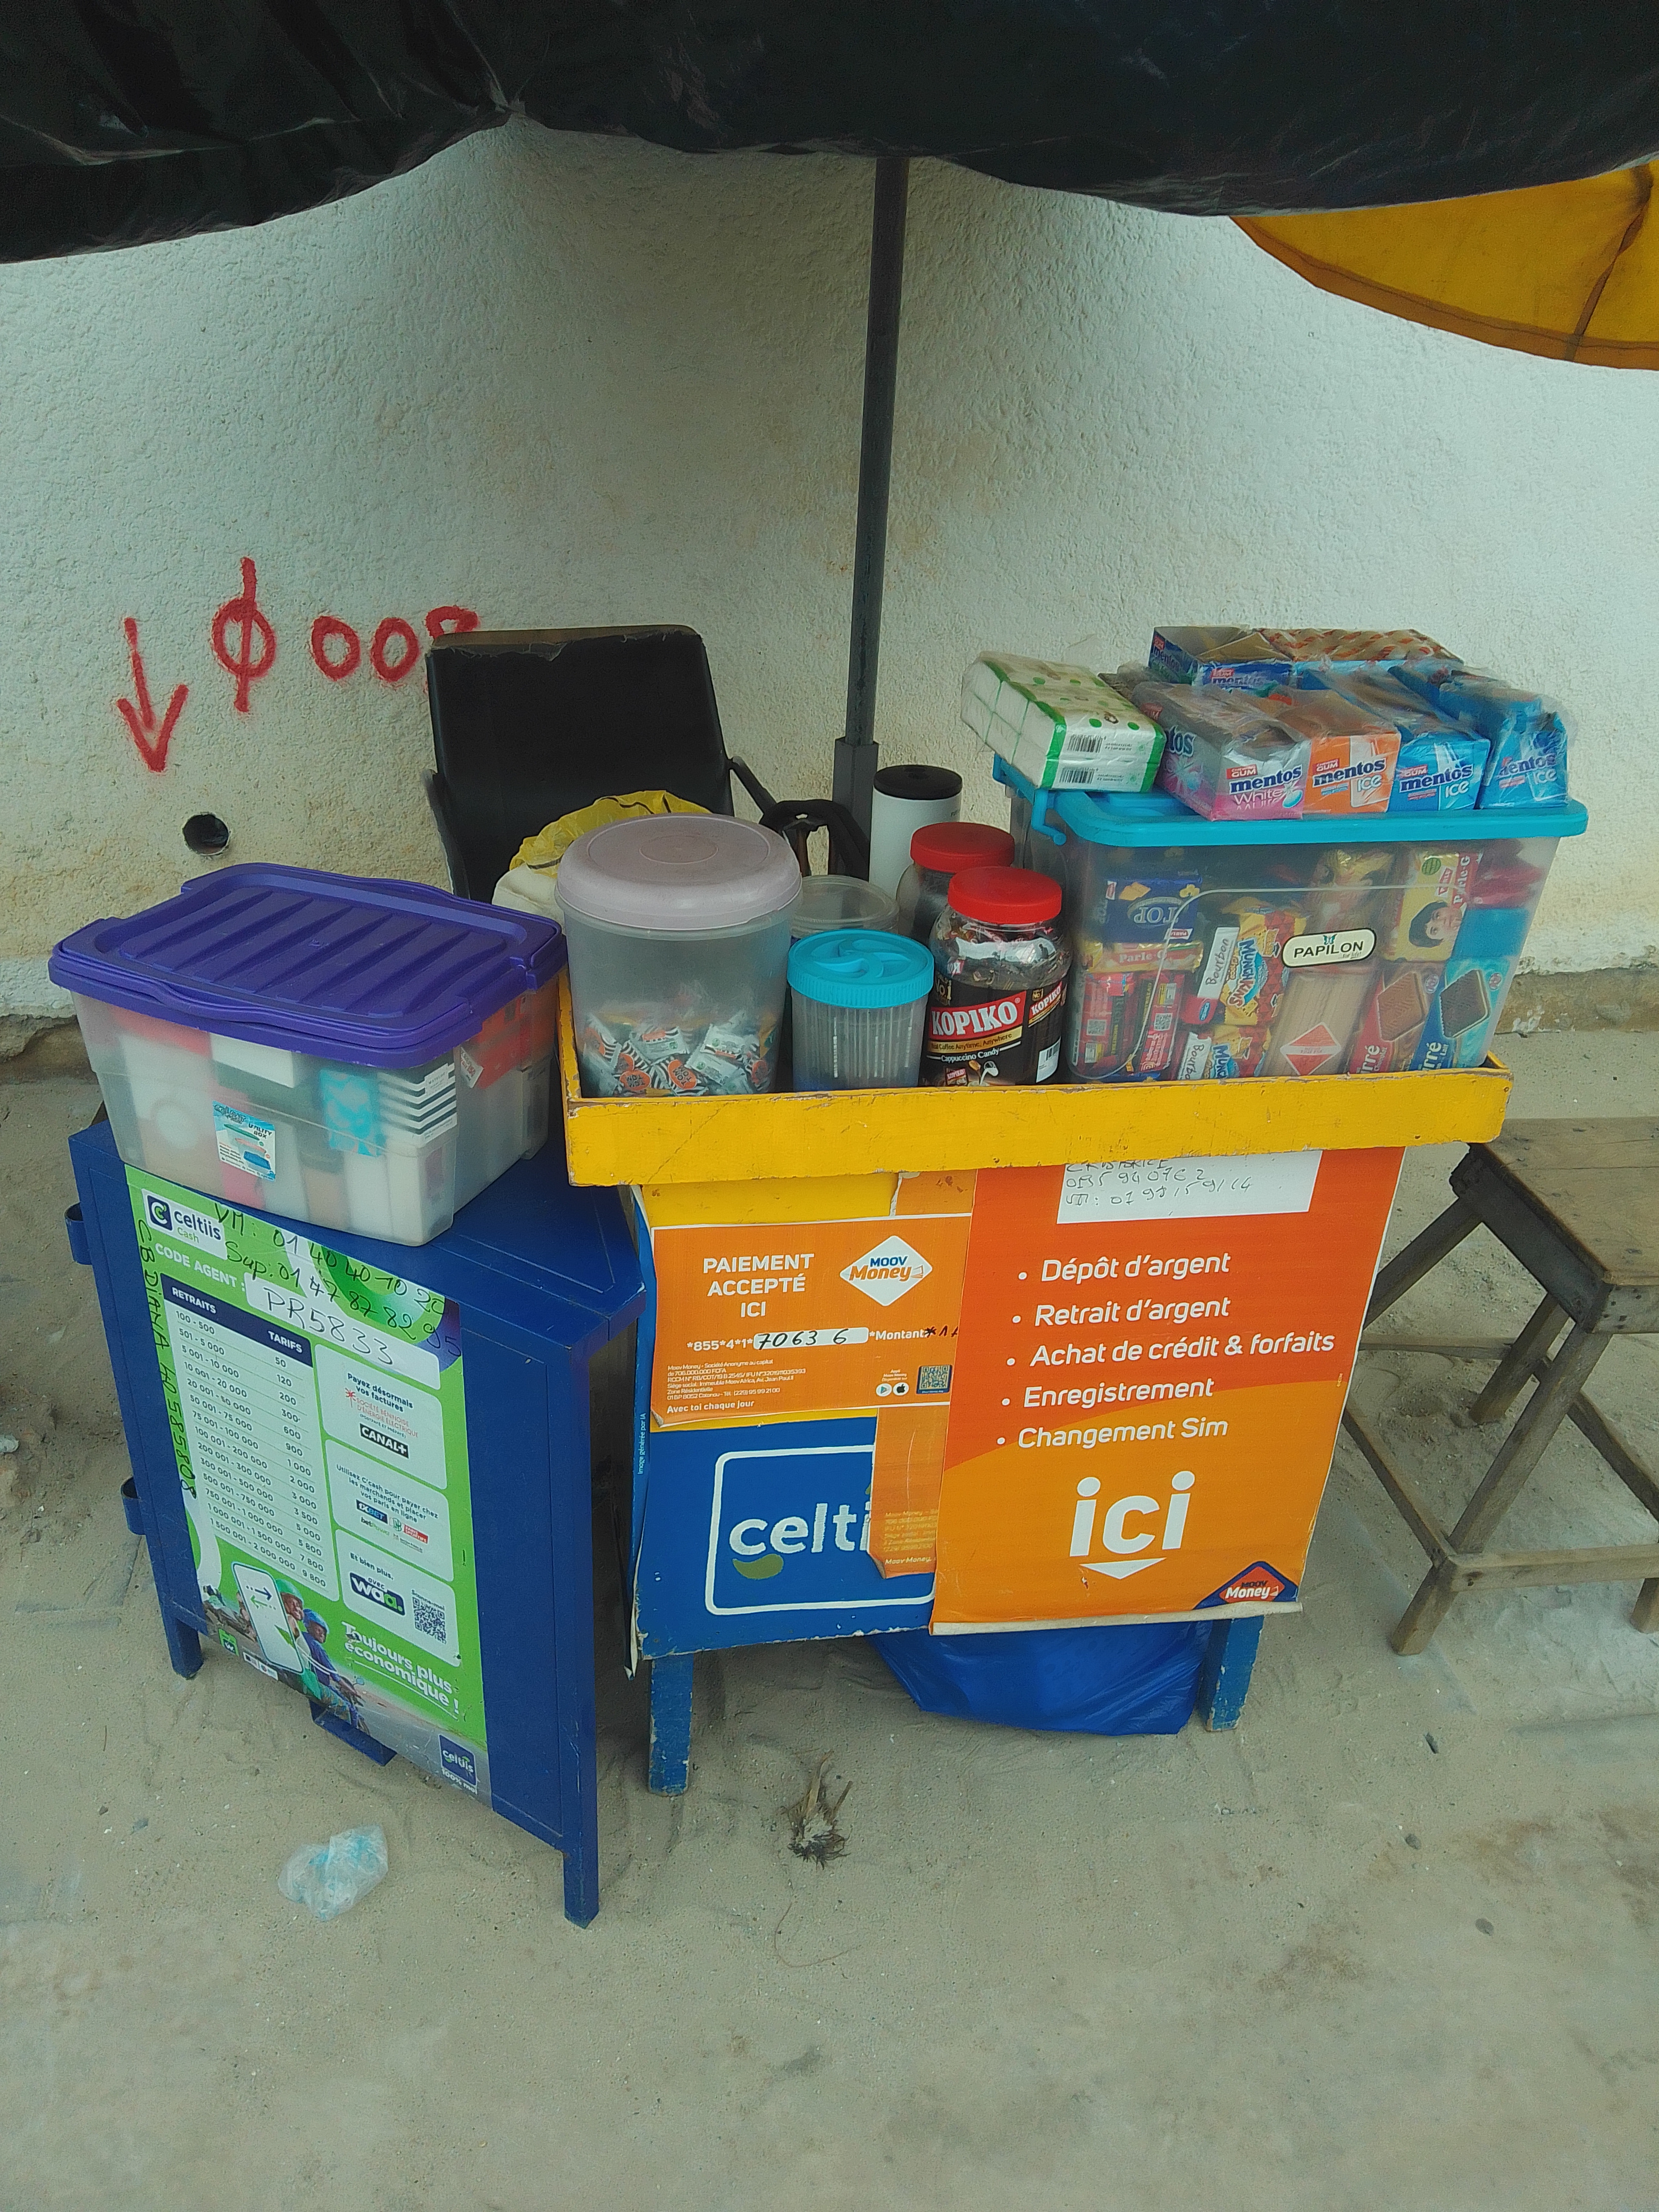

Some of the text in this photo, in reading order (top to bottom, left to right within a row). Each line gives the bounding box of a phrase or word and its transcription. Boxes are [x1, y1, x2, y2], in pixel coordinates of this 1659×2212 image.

[1230, 766, 1302, 793] mentos
[1231, 769, 1256, 778] GUM
[1313, 759, 1385, 786] mentos
[1316, 761, 1338, 772] GUM
[1401, 765, 1473, 792] mentos
[1234, 788, 1283, 805] White
[1205, 939, 1230, 985] Bourbon
[1293, 941, 1364, 958] PAPILON
[1031, 984, 1061, 1015] KOPIKO
[932, 1001, 1018, 1036] KOPIKO
[939, 1042, 955, 1051] Coffee
[983, 1033, 1012, 1046] Anywhere
[941, 1048, 1000, 1064] Cappuccino Candy
[1185, 1044, 1205, 1079] Bourbo
[1212, 1045, 1229, 1078] MUNC
[253, 1130, 267, 1139] BOX
[174, 1210, 221, 1241] celtiis
[177, 1226, 200, 1244] Cash
[155, 1243, 237, 1288] CODE AGENT
[702, 1253, 815, 1274] PAIEMENT
[849, 1264, 912, 1282] Money
[869, 1255, 908, 1267] MOOV
[1041, 1256, 1119, 1285] Dépôt
[707, 1273, 806, 1297] ACCEPTÉ
[172, 1286, 303, 1354] RETRAITS TARIFS
[740, 1301, 767, 1318] ICI
[1034, 1301, 1122, 1327] Retrait
[175, 1311, 286, 1368] 100 500 50
[1029, 1331, 1335, 1368] Achat de crédit & forfaits
[179, 1328, 193, 1340] 501
[276, 1374, 292, 1387] 120
[279, 1392, 296, 1405] 200
[347, 1372, 413, 1409] Payez désormais
[356, 1385, 404, 1412] vos factures
[1023, 1378, 1215, 1409] Enregistrement
[281, 1409, 299, 1423] 300
[667, 1400, 755, 1414] Avec toi chaque jour
[283, 1426, 301, 1440] 600
[362, 1426, 407, 1455] CANAL+
[1017, 1416, 1229, 1449] Changement Sim
[286, 1443, 303, 1457] 900
[336, 1464, 361, 1481] Utilisez
[384, 1489, 400, 1501] pour
[401, 1497, 421, 1511] payer
[422, 1507, 439, 1519] chez
[349, 1477, 358, 1487] les
[359, 1484, 396, 1506] marchands
[405, 1504, 426, 1520] placer
[360, 1490, 418, 1523] vos paris en ligne
[1069, 1470, 1195, 1557] ici
[729, 1501, 872, 1555] celti
[350, 1552, 358, 1562] Et
[359, 1556, 375, 1571] bien
[367, 1576, 386, 1590] avec
[1225, 1586, 1271, 1599] Money
[341, 1620, 453, 1695] Toujours plus
[344, 1641, 450, 1707] économique
